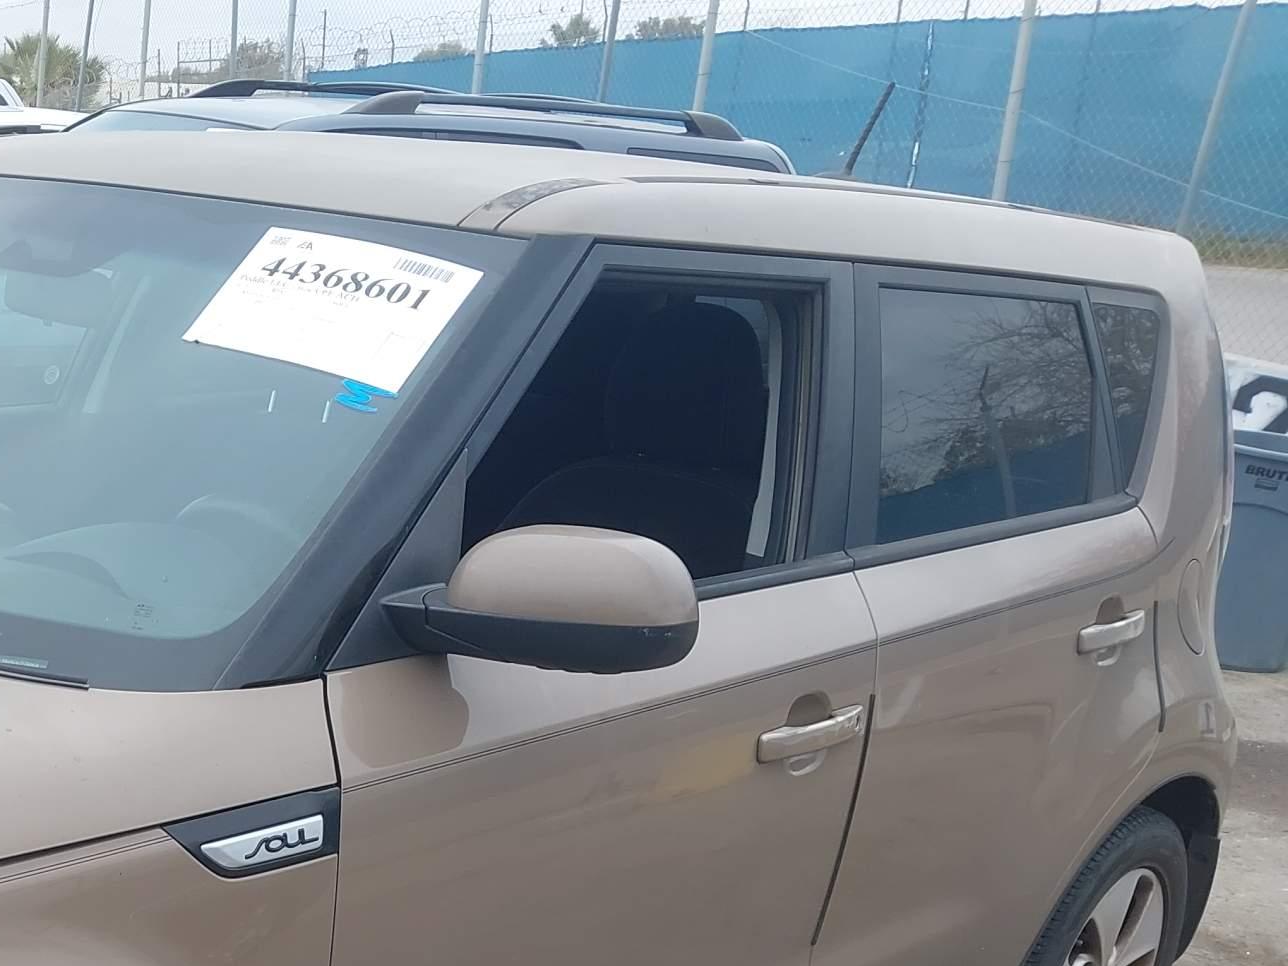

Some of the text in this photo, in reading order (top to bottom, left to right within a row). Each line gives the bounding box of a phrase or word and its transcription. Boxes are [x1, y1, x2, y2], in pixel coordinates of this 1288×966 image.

[261, 257, 431, 310] 44368601
[1245, 465, 1288, 482] BRUT
[245, 828, 319, 859] SOUL
